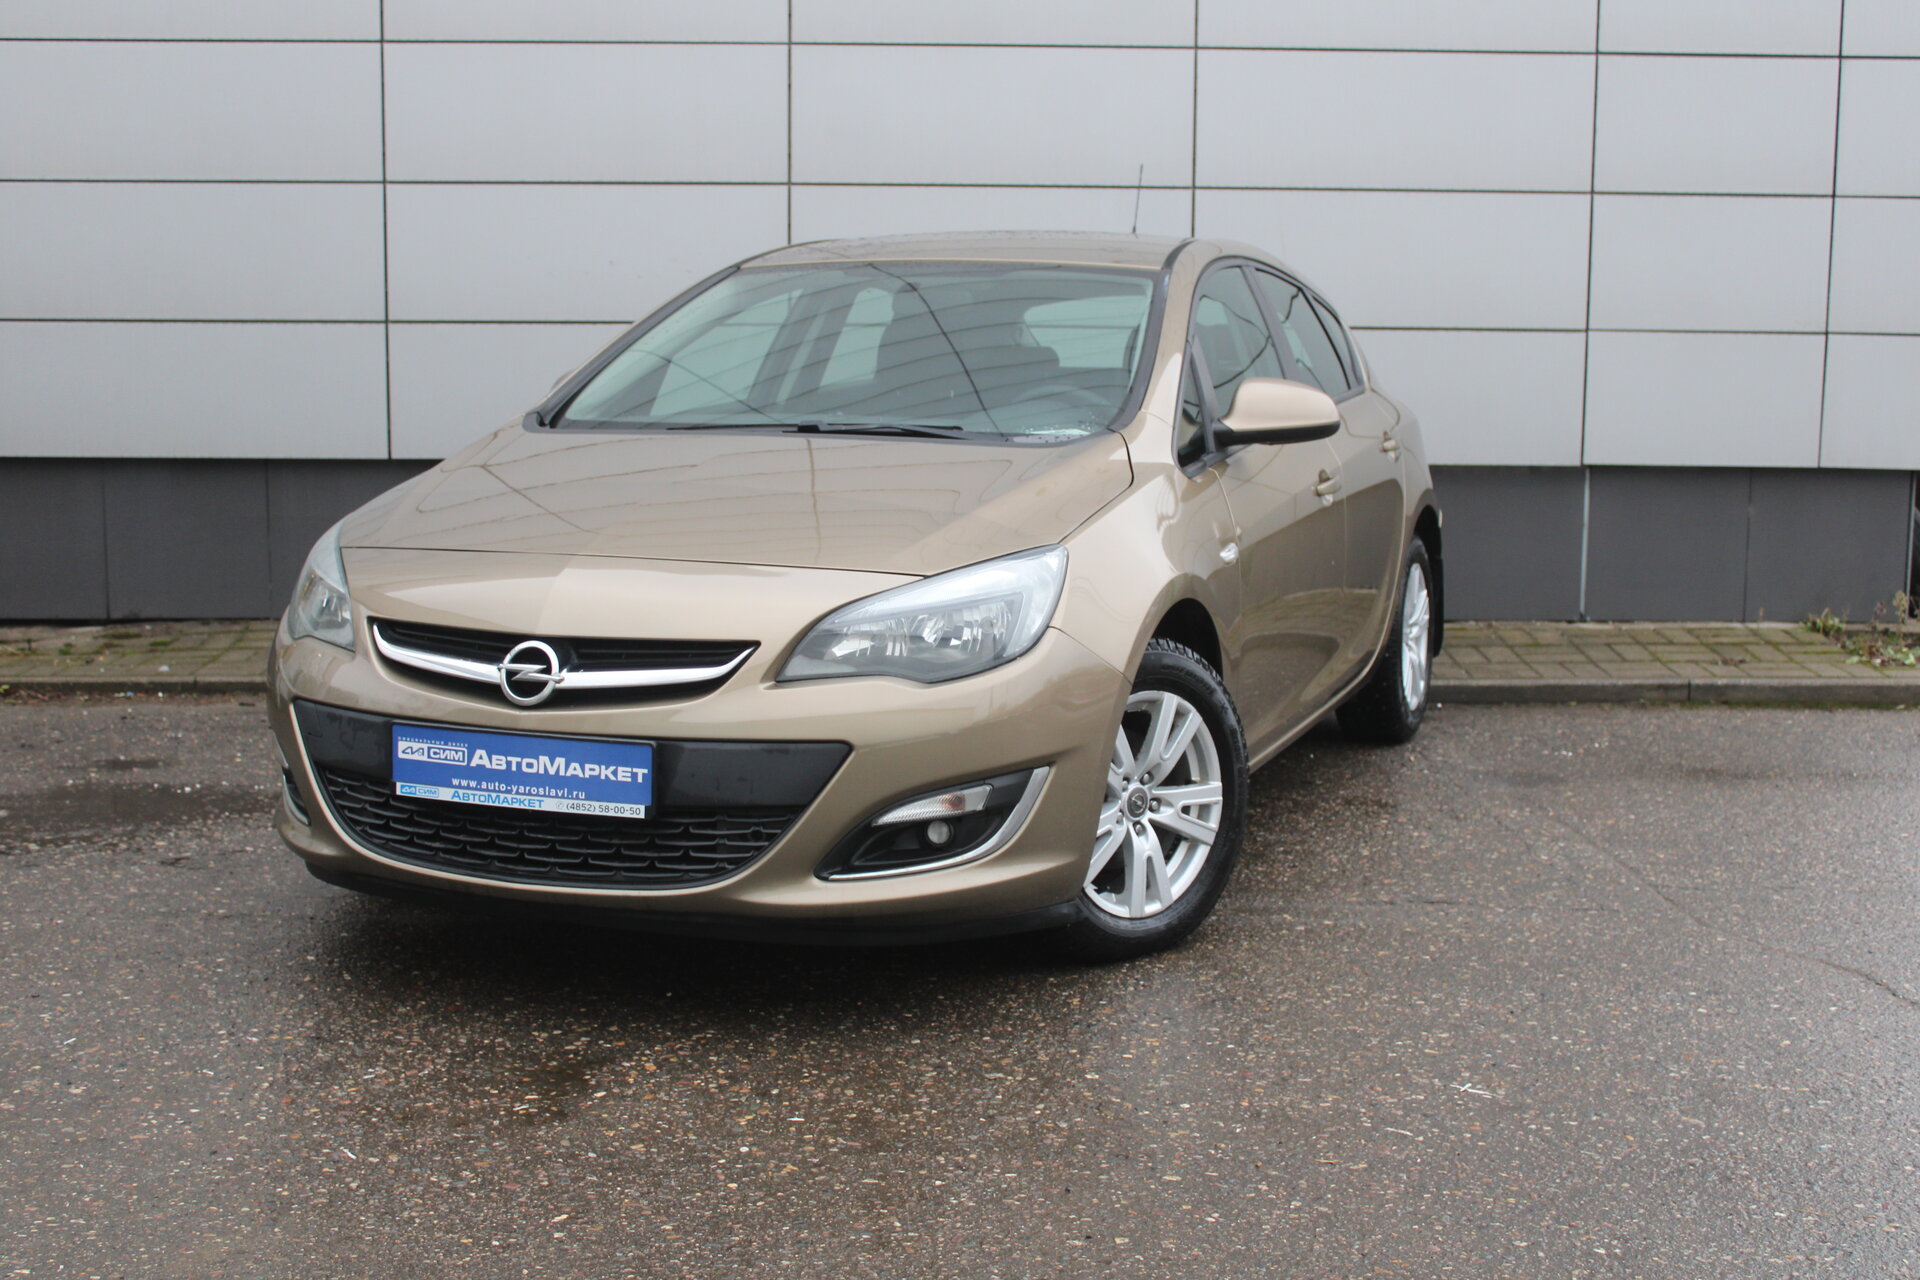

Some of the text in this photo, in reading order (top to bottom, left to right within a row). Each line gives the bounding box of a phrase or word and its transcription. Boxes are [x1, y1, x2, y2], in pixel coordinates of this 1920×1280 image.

[430, 748, 463, 762] СИМ
[451, 777, 586, 799] www.auto-yaroslavl.ru
[566, 803, 641, 815] (4852) 58-00-50
